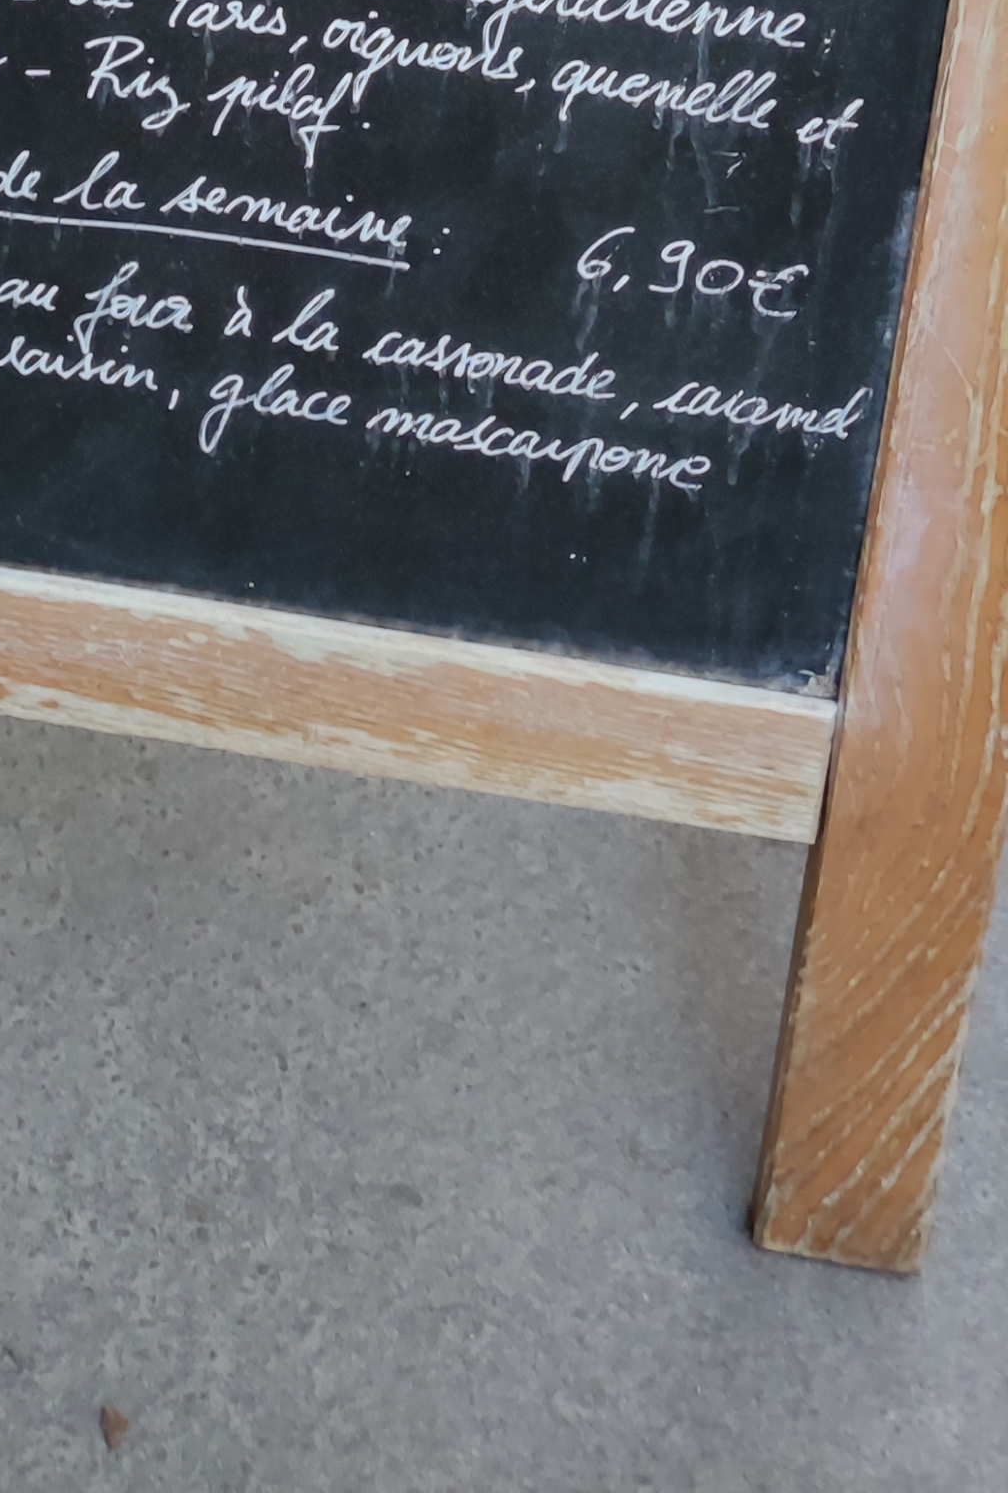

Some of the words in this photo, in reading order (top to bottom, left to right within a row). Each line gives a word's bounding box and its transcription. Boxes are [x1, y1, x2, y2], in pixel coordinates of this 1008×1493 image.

[83, 35, 191, 131] Riz
[551, 58, 779, 125] quenelle
[796, 97, 866, 150] et
[54, 150, 145, 211] la
[160, 175, 412, 247] semaine
[576, 226, 810, 319] 6,90€
[74, 261, 194, 355] four
[223, 285, 253, 338] à
[272, 288, 339, 353] la
[363, 330, 640, 421] cassonade,
[198, 364, 352, 455] glace
[365, 406, 711, 490] mascarpone
